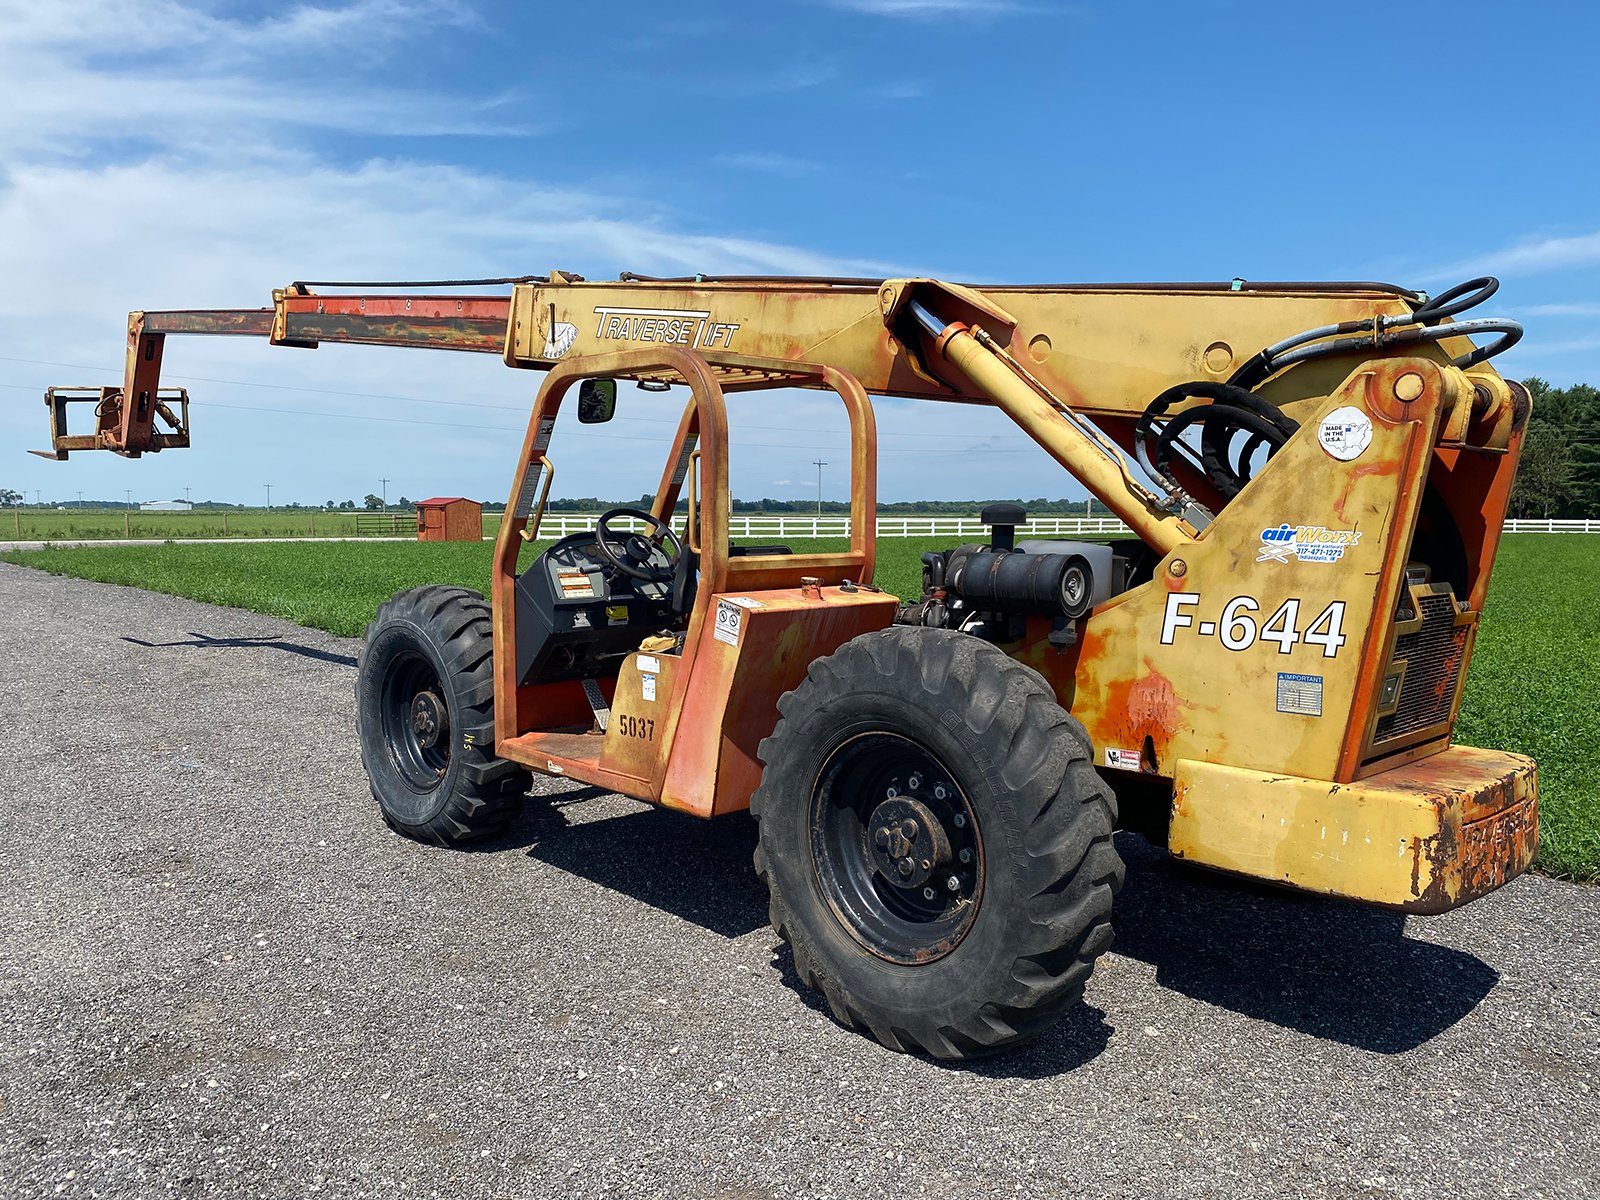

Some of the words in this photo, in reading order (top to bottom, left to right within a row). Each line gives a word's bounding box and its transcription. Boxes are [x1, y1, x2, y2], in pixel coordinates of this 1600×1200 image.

[593, 306, 711, 344] TRAVERSE
[1262, 525, 1358, 544] airWorx
[1296, 548, 1343, 556] 317-471-1272
[1160, 592, 1347, 659] F-644
[1285, 674, 1322, 683] IMPORTANT
[620, 714, 655, 742] 5037
